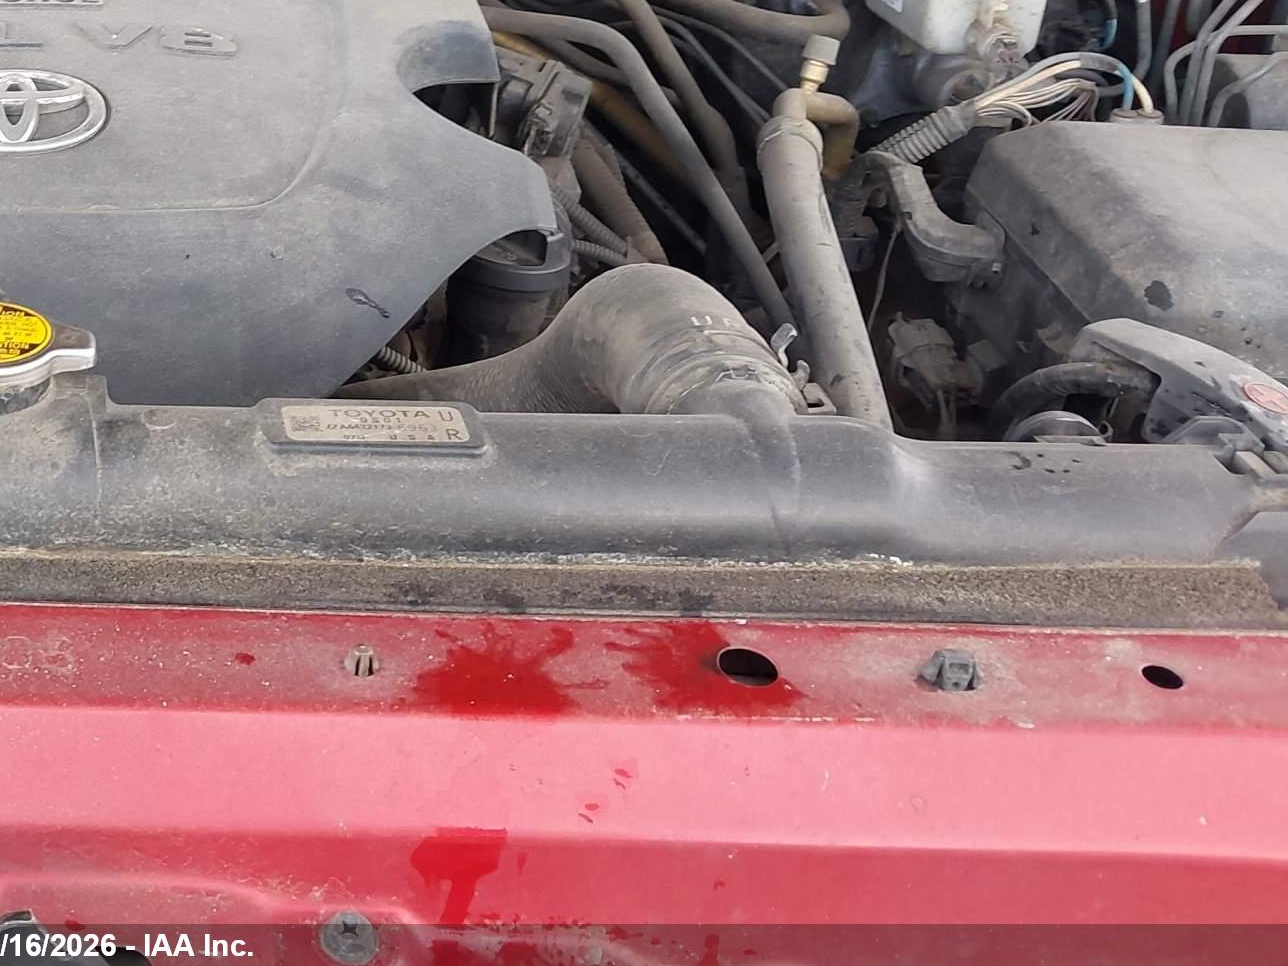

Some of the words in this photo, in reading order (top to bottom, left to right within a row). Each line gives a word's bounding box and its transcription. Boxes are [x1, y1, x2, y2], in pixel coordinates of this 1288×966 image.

[77, 23, 238, 57] V8
[327, 409, 431, 420] TOYOTA
[438, 410, 455, 423] U
[445, 428, 463, 441] R
